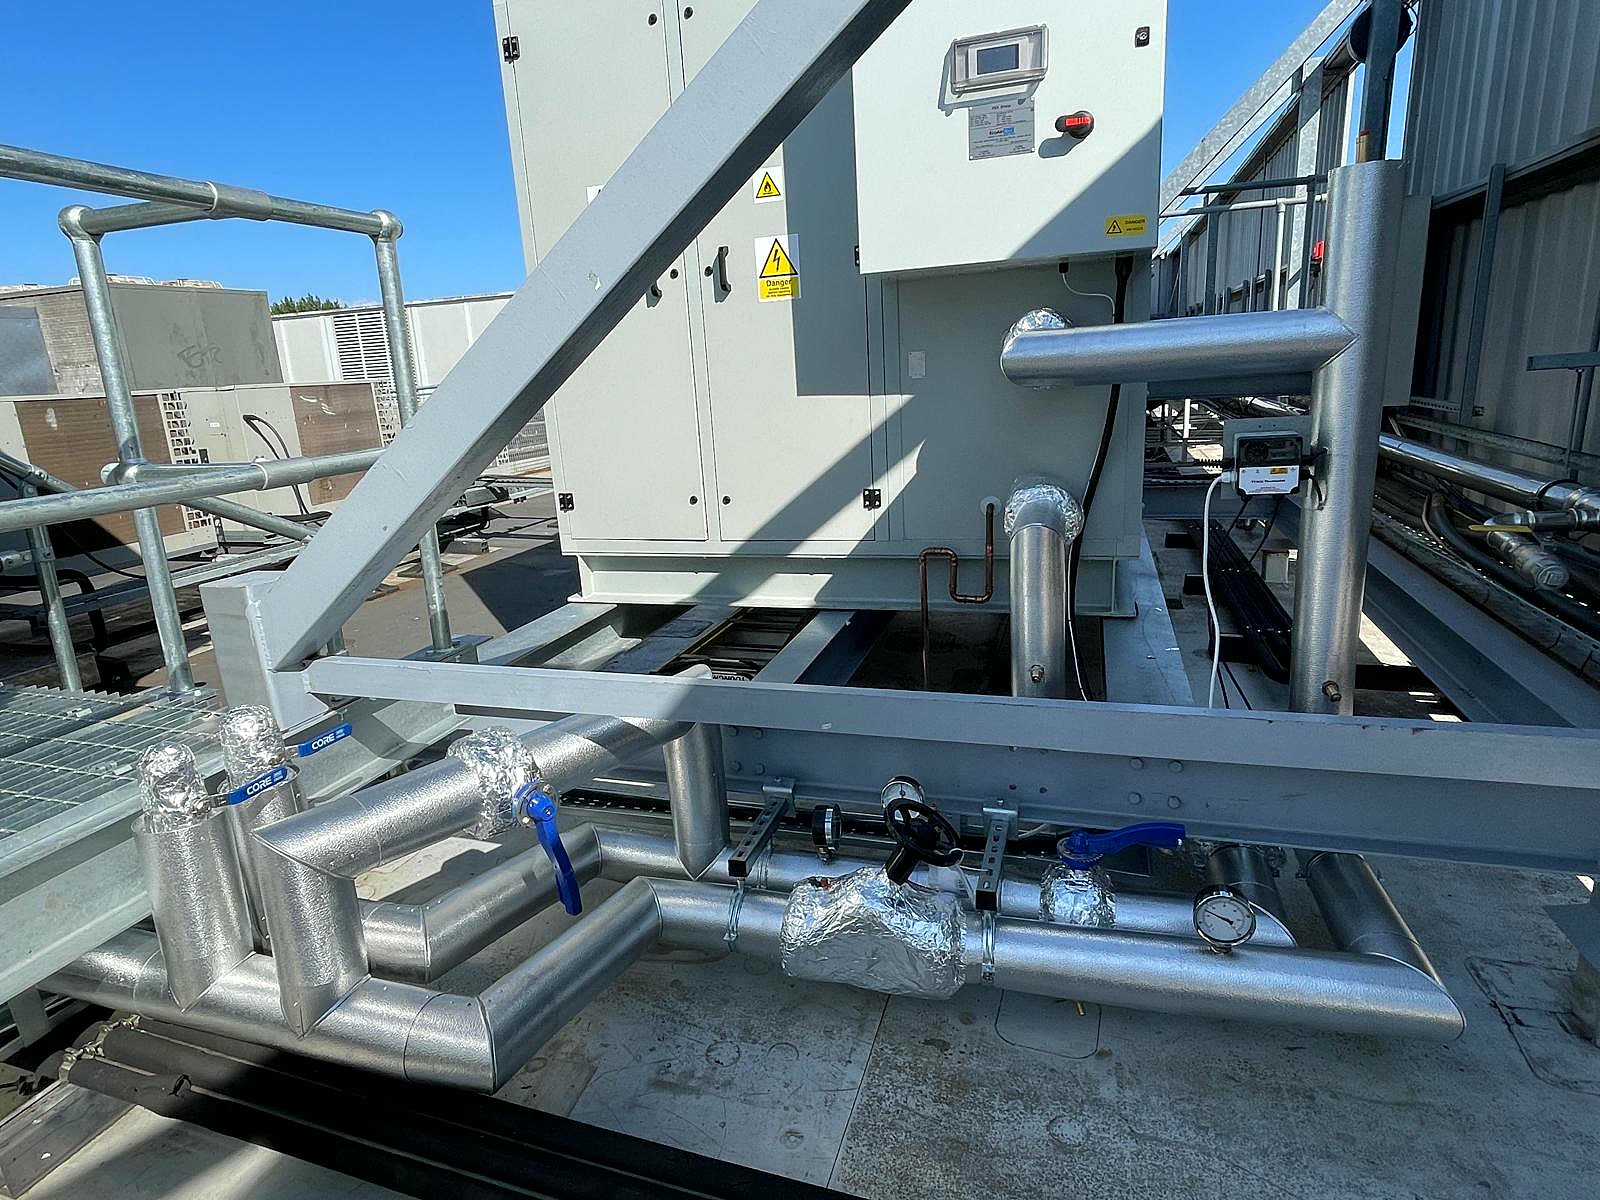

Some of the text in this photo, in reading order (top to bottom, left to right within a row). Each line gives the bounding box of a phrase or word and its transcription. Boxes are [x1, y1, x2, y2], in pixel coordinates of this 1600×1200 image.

[765, 279, 793, 287] Danger
[311, 732, 335, 750] CORE
[246, 775, 272, 795] CORE
